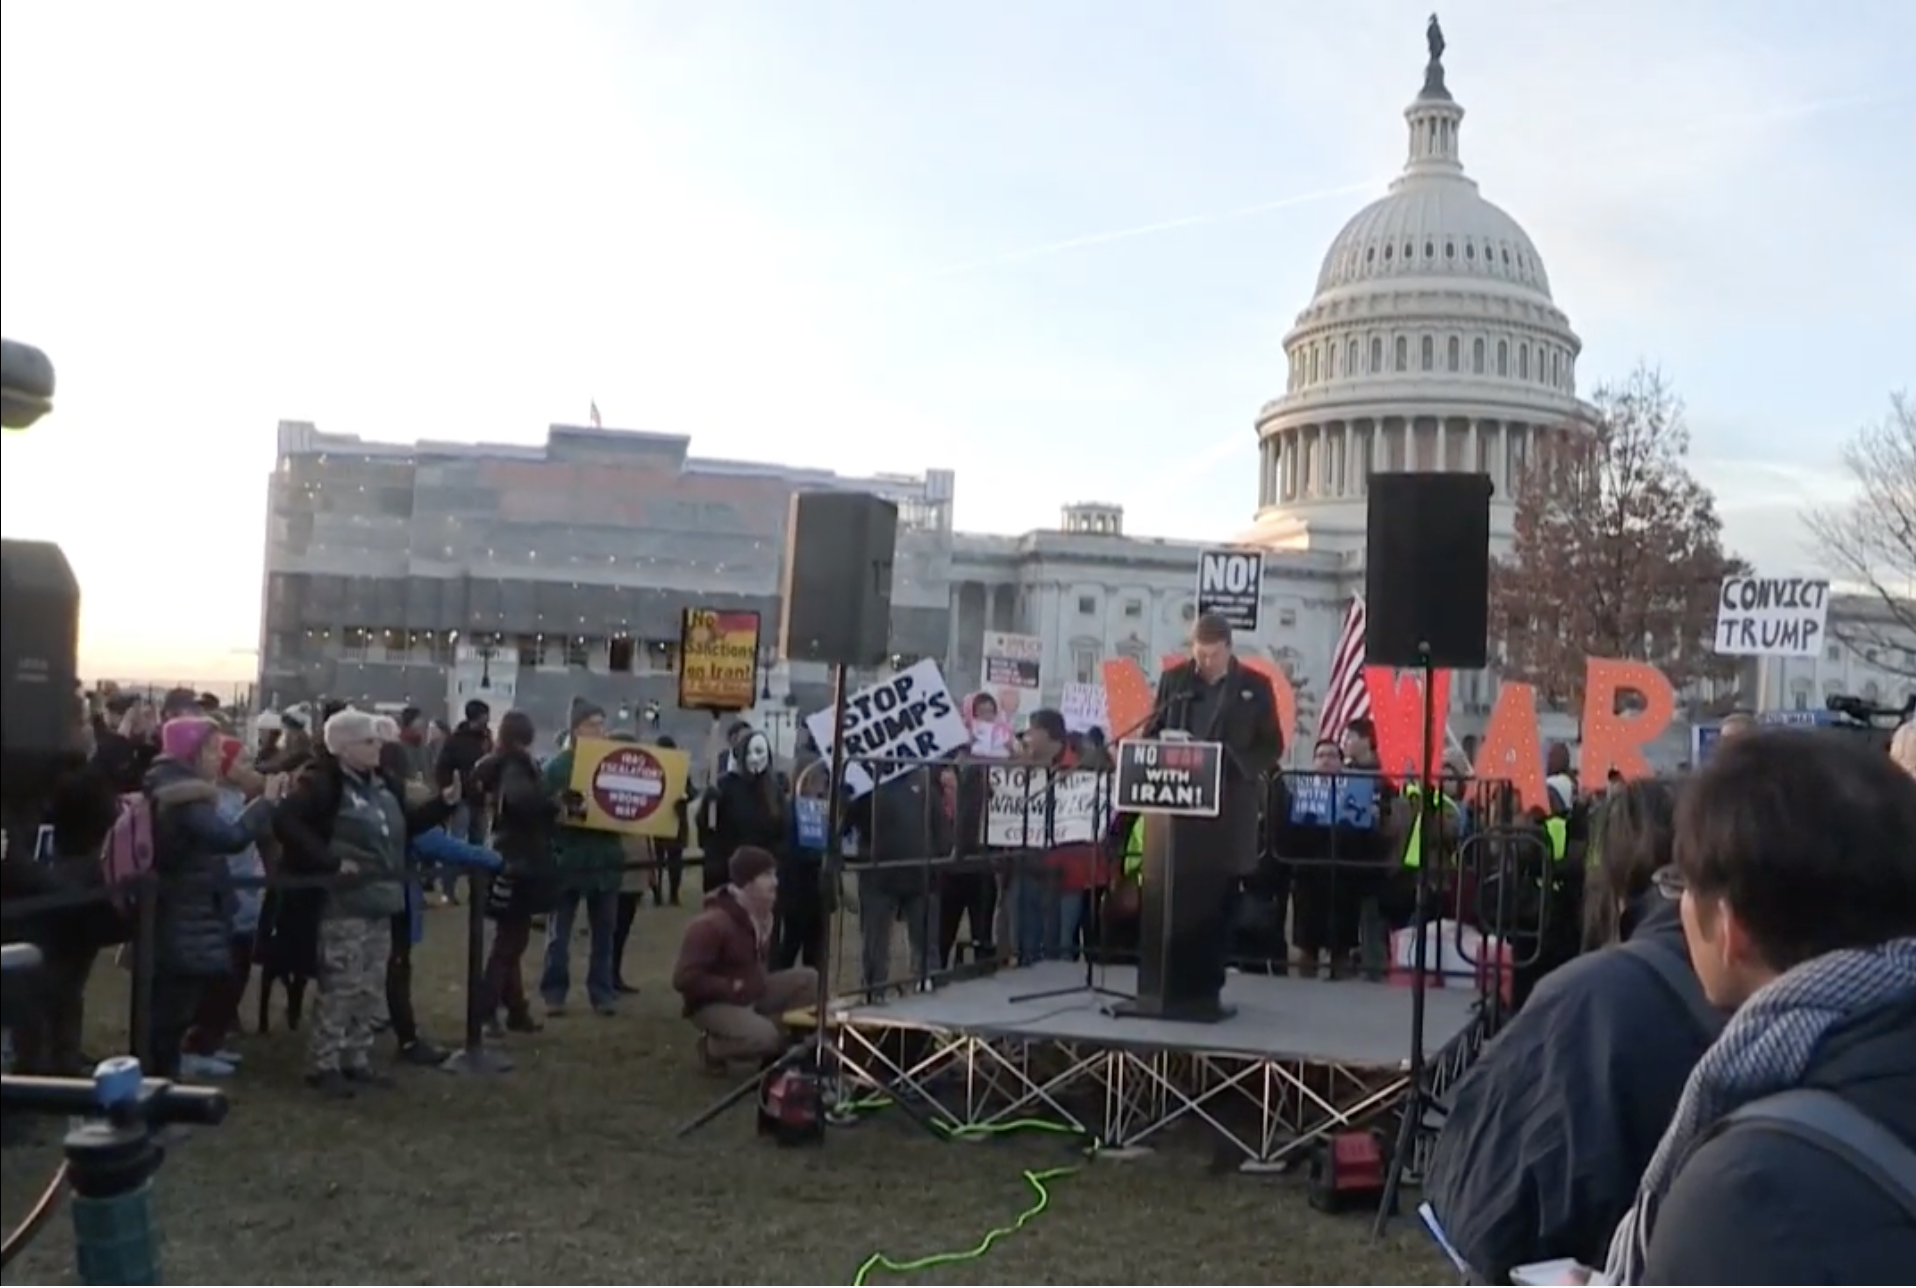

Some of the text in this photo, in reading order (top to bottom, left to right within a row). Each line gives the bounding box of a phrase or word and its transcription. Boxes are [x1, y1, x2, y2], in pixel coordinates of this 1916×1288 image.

[1203, 555, 1257, 594] NO!
[1723, 579, 1829, 610] CONVICT
[692, 611, 715, 629] No
[1720, 617, 1819, 650] TRUMP
[842, 675, 914, 729] STOP
[826, 690, 951, 756] RUMP'S
[1364, 656, 1675, 815] WAR
[1134, 745, 1158, 766] NO
[1146, 767, 1190, 783] WITH
[1131, 783, 1202, 804] IRAN!
